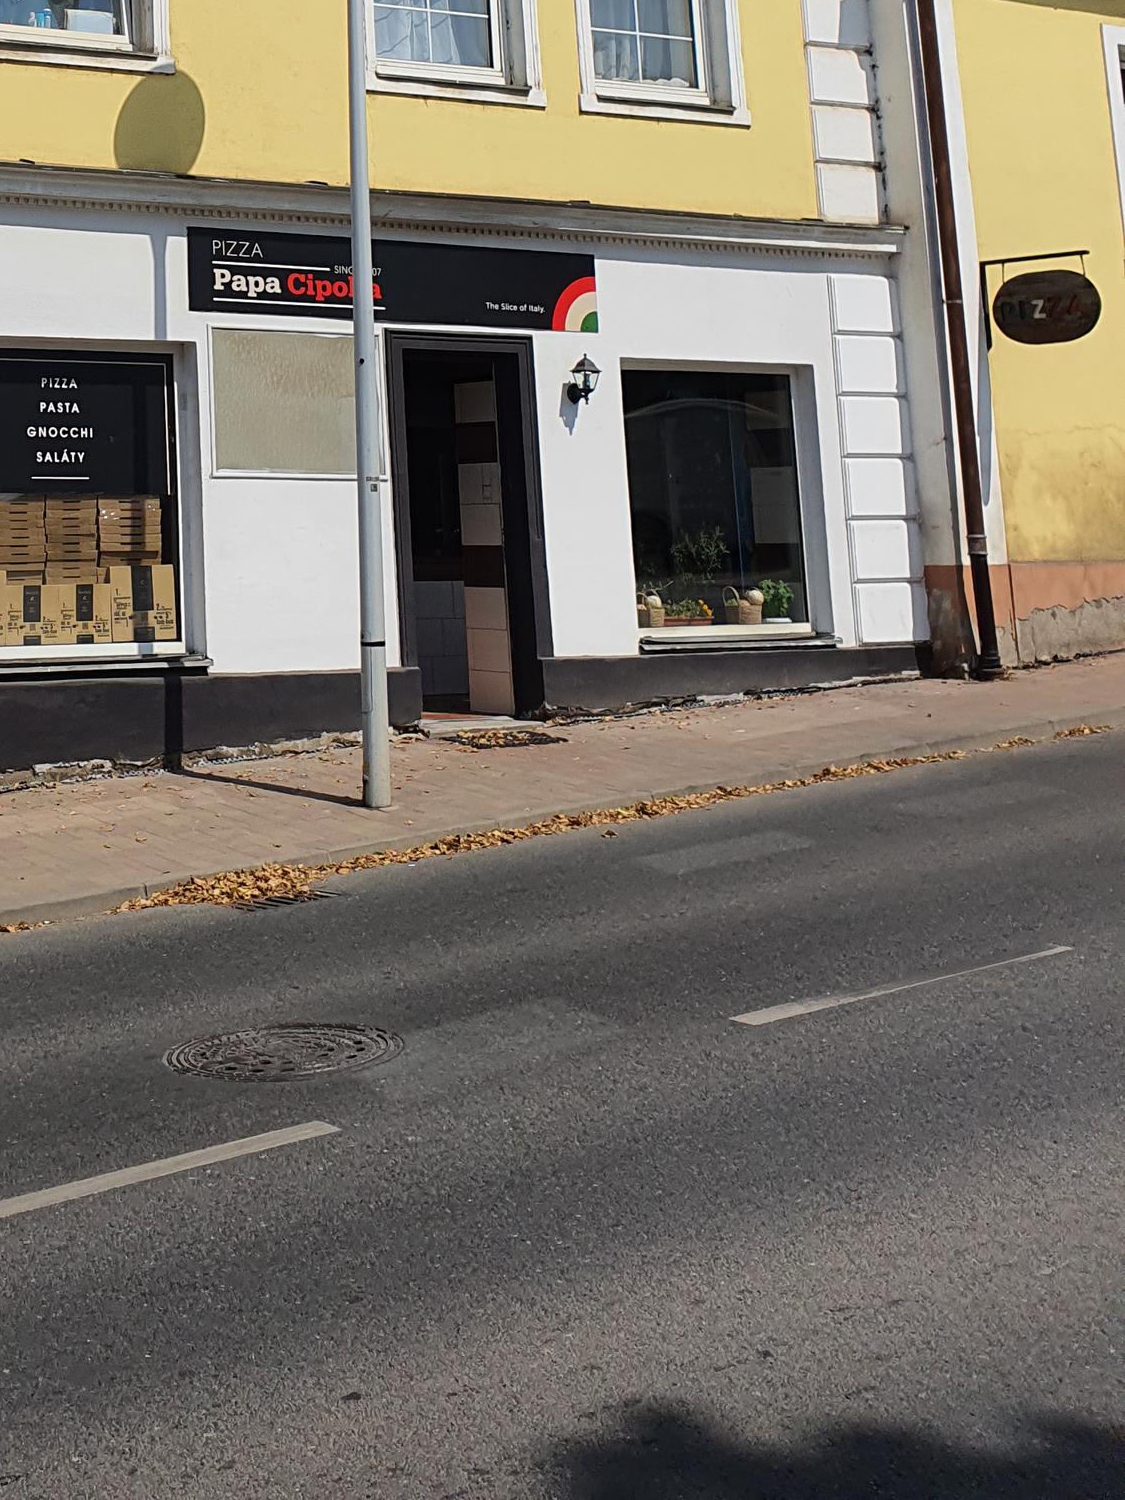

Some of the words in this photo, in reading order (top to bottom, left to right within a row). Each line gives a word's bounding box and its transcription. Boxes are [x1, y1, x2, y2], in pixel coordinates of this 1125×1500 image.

[212, 240, 263, 258] PIZZA
[334, 265, 353, 275] SINC
[213, 268, 282, 297] Papa
[287, 273, 382, 301] Cipola
[485, 301, 499, 310] The
[501, 302, 517, 311] Slice
[519, 303, 527, 312] of
[529, 304, 546, 314] Italy.
[41, 377, 78, 389] PIZZA
[39, 401, 80, 414] PASTA
[26, 426, 93, 438] GNOCCHI
[36, 449, 85, 463] SALÁTY
